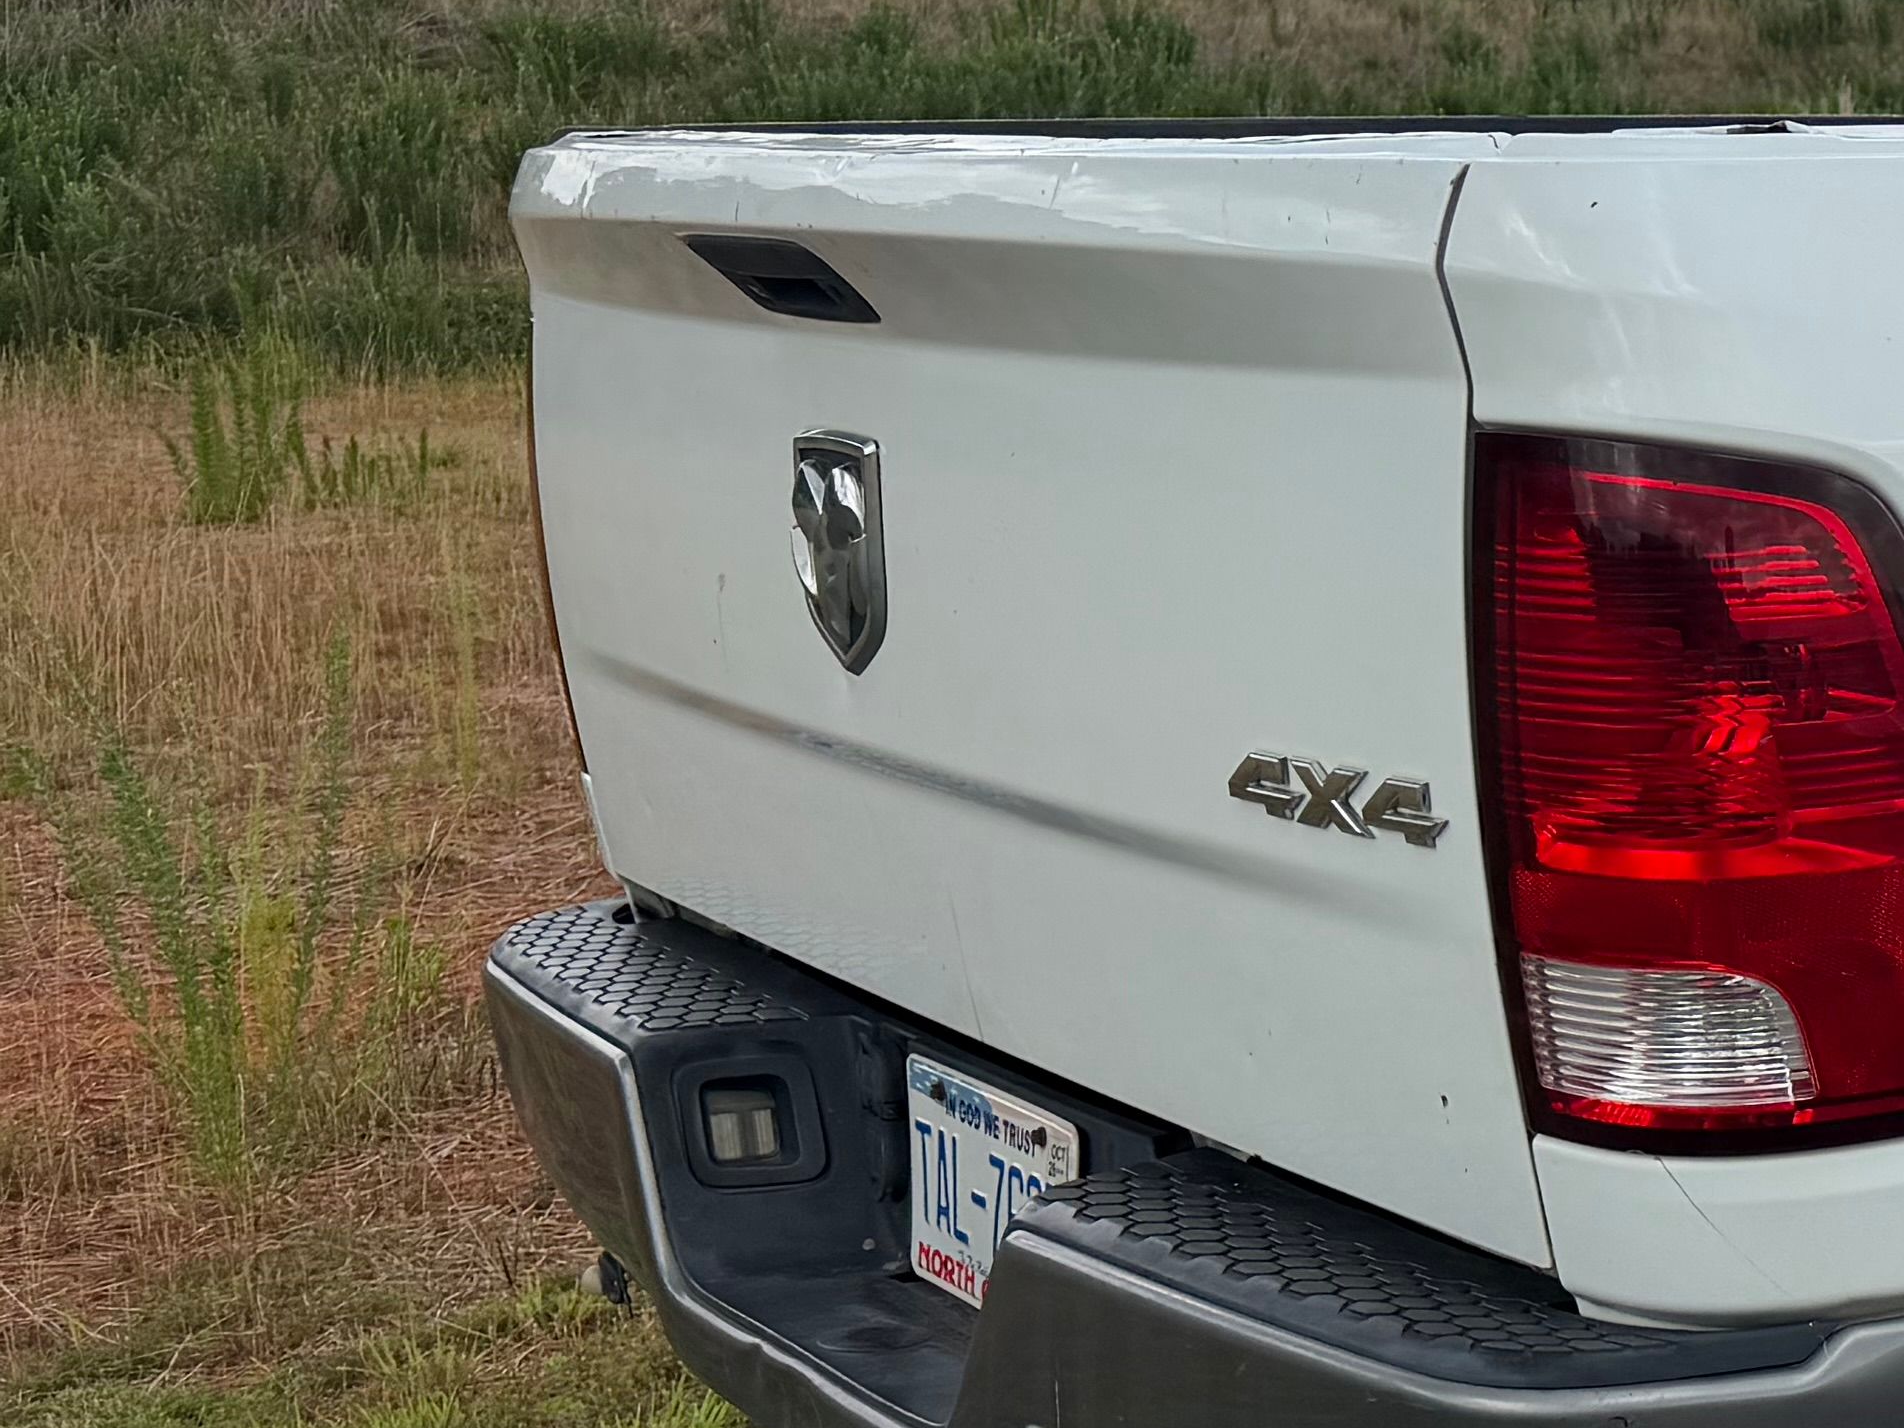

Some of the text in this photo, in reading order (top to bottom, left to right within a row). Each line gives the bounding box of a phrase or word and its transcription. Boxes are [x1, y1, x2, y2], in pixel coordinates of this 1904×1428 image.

[944, 1091, 956, 1119] IN
[958, 1099, 982, 1131] GOD
[983, 1111, 1000, 1140] WE
[918, 1240, 977, 1300] NORTH
